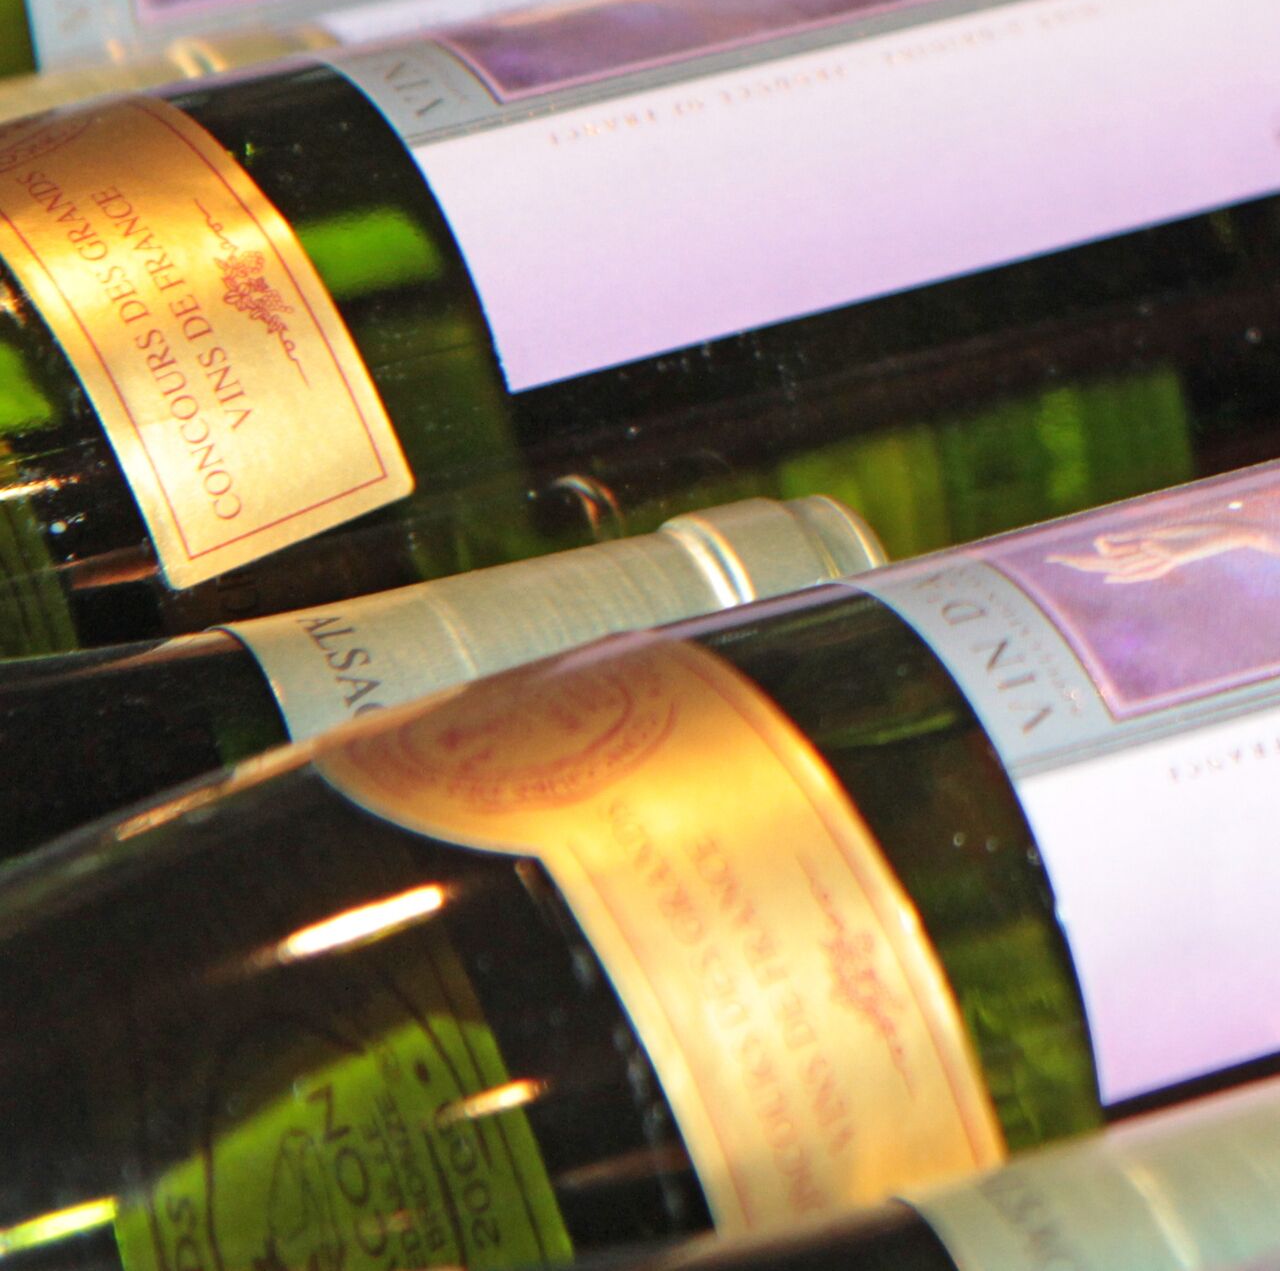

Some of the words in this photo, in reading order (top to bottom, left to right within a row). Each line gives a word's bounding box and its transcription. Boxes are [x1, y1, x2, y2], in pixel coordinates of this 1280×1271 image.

[15, 170, 113, 264] GRANDS
[97, 183, 185, 291] FRANCE
[98, 263, 152, 327] DES
[171, 290, 213, 344] DE
[135, 330, 243, 524] CONCOURS
[197, 347, 252, 432] VINS
[971, 636, 1054, 736] VIN
